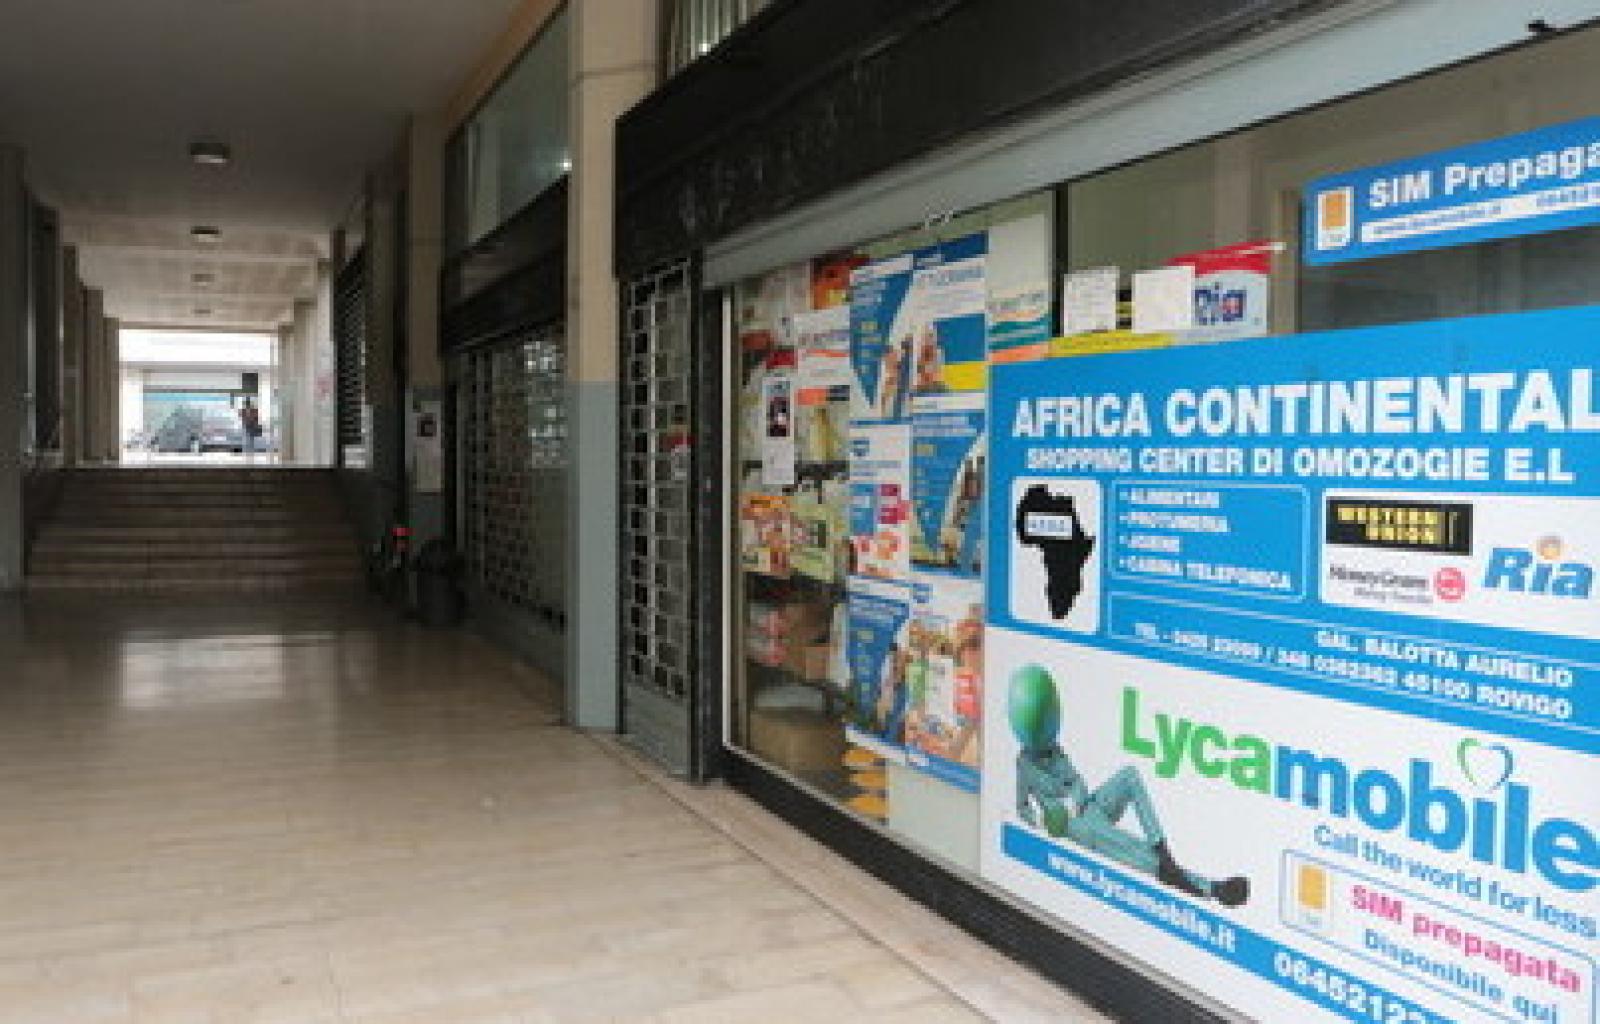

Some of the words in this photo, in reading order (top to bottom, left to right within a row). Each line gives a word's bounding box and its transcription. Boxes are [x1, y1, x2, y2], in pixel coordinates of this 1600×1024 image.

[1369, 170, 1433, 210] SIM
[1012, 392, 1151, 438] AFRICA
[1166, 368, 1600, 438] CONTINENTAL
[1027, 447, 1132, 471] SHOPPING
[1139, 447, 1243, 474] CENTER
[1254, 448, 1284, 476] DI
[1293, 446, 1490, 481] OMOZOGIE
[1337, 507, 1444, 526] WESTERN
[1365, 525, 1444, 546] UNION
[1483, 534, 1594, 600] Ria
[1365, 637, 1458, 668] BALOTTA
[1464, 654, 1573, 688] AURELIO
[1476, 683, 1573, 719] ROVIGO
[1121, 685, 1600, 893] Lycamobile
[1314, 824, 1358, 858] Call
[1362, 840, 1401, 872] the
[1408, 858, 1482, 901] world
[1489, 880, 1529, 914] for
[1535, 896, 1597, 939] less
[1352, 884, 1403, 925] SIM
[1412, 911, 1581, 994] prepagata
[1365, 928, 1505, 1001] Disponibile
[1512, 994, 1558, 1024] qui
